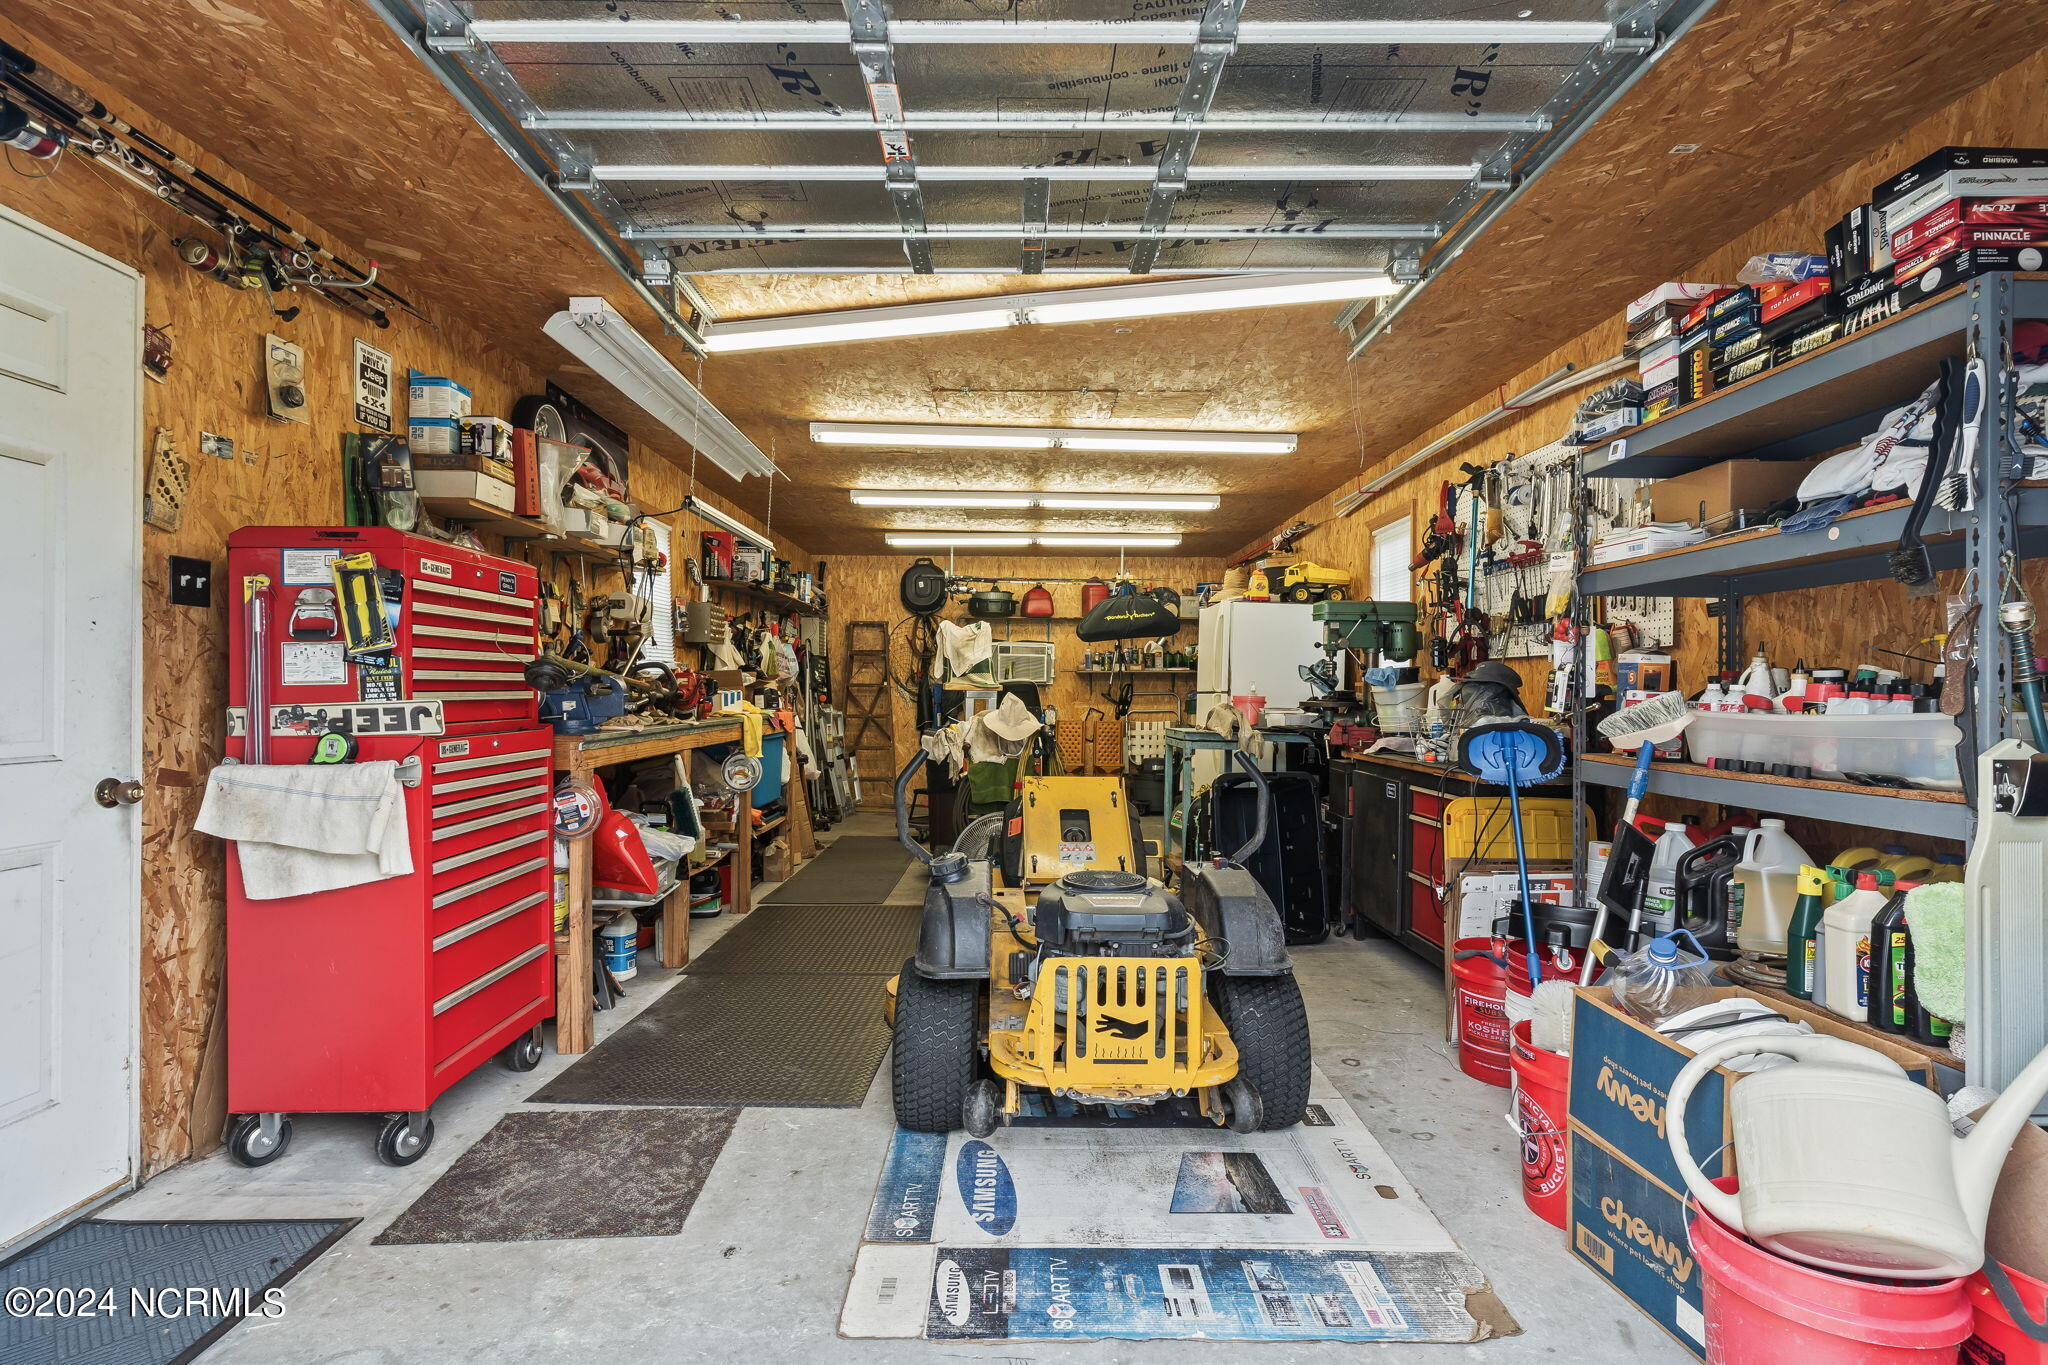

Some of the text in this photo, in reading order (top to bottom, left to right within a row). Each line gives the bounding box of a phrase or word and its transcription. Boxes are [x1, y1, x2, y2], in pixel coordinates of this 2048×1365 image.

[1047, 70, 1129, 91] combustible
[1973, 230, 2031, 242] PINNACLE
[1846, 279, 1885, 308] SPALDING
[362, 354, 386, 372] DRIVE A
[1693, 350, 1703, 399] NITRO
[364, 368, 385, 386] Jeep
[361, 395, 386, 412] 4X4
[367, 414, 378, 426] YOU
[327, 706, 433, 733] JEEP
[1468, 1028, 1489, 1039] PICKLE
[1603, 1055, 1619, 1070] shop
[1619, 1065, 1641, 1087] lovers
[1597, 1066, 1666, 1139] hewy
[1540, 1146, 1565, 1194] BUCKET
[972, 1149, 998, 1223] SAMSUNG
[1601, 1196, 1693, 1283] chewy
[1607, 1229, 1629, 1250] where
[1629, 1243, 1643, 1263] pet
[1665, 1269, 1686, 1294] shop
[943, 1267, 961, 1318] SAMSUNG
